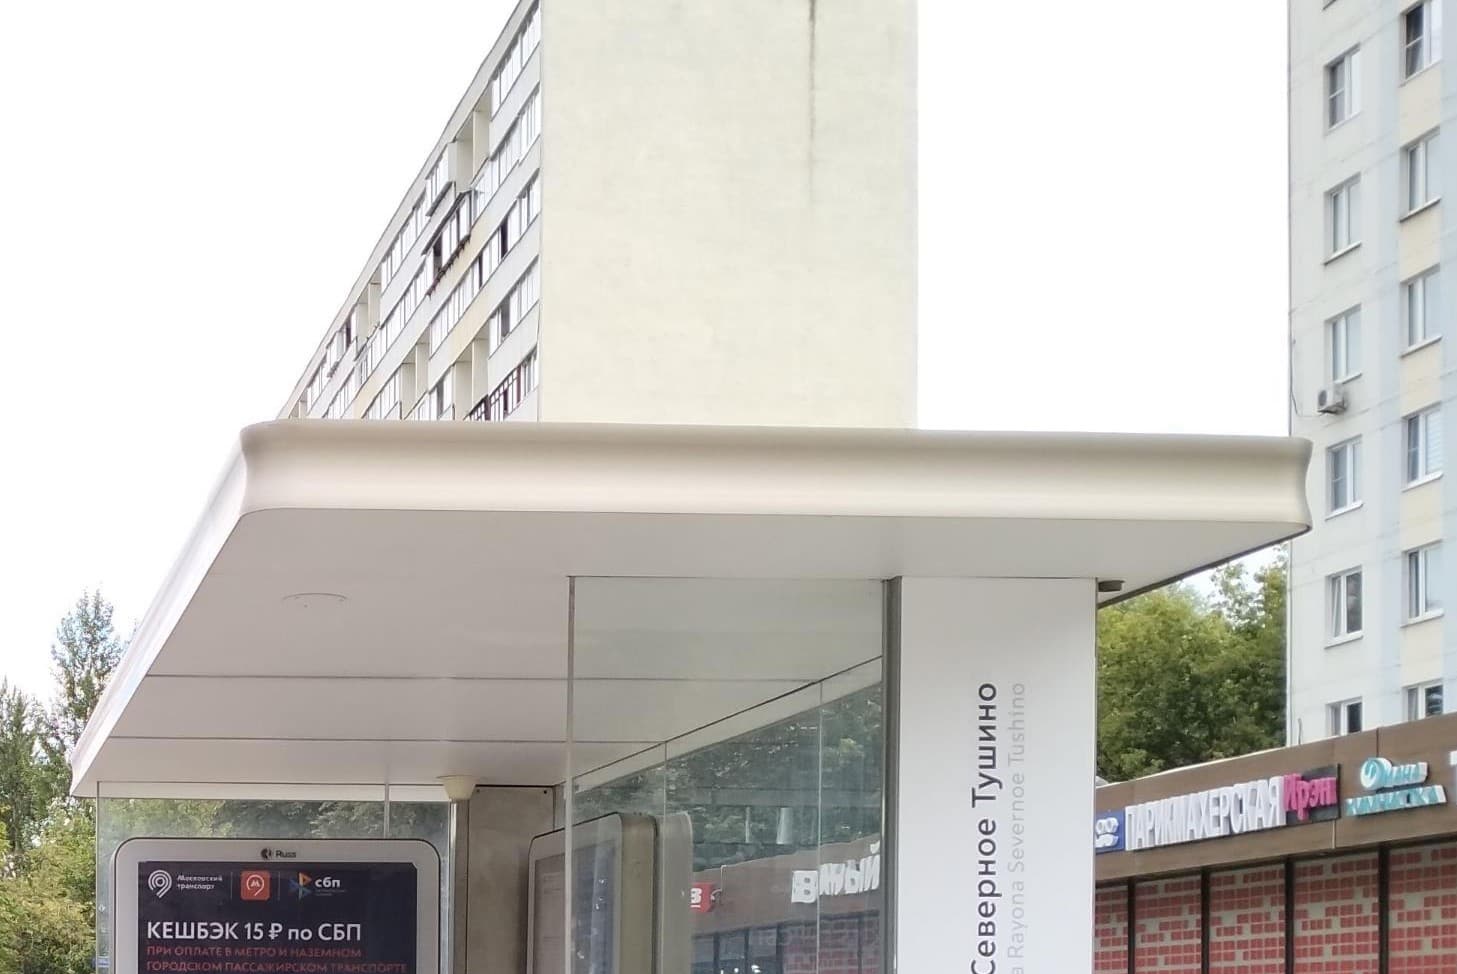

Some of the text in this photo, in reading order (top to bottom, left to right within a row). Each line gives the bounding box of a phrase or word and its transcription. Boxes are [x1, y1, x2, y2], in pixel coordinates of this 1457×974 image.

[971, 682, 1002, 807] Тушино
[1008, 682, 1024, 768] Tushino
[1008, 771, 1024, 874] Severnoe
[1124, 775, 1286, 850] ПАРИКМАХЕРСКАЯ
[1284, 773, 1337, 821] Ирэн
[275, 848, 297, 858] Russ
[314, 876, 341, 888] сбп
[147, 921, 239, 940] КЕШБЭК
[244, 922, 264, 940] 15
[288, 928, 313, 941] по
[318, 923, 361, 942] СБП
[1008, 882, 1028, 959] Rayona
[147, 946, 362, 958] ПРИ ОПЛАТЕ В МЕТРО И НАЗЕМНОМ
[147, 961, 407, 973] ГОРОДСКОМ ПАССАЖИРСКОМ ТРАНСПОРТЕ
